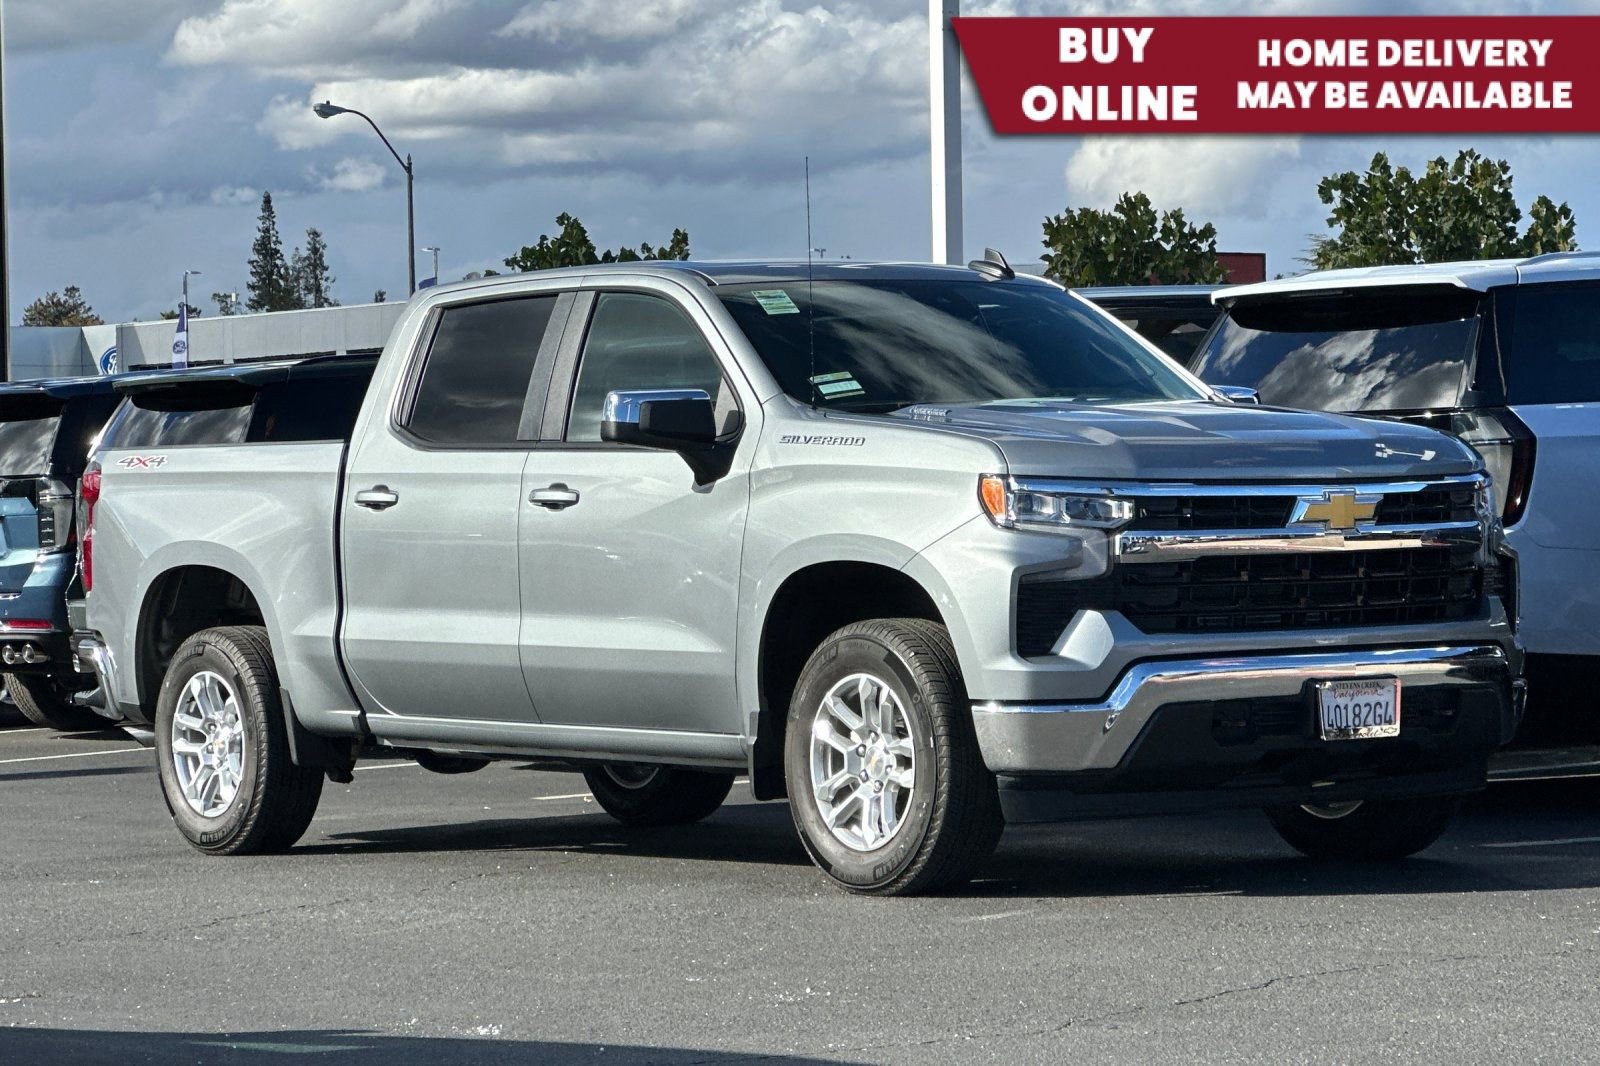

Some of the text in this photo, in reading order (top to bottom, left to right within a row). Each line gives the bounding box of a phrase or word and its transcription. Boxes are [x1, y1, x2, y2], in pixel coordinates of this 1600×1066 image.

[779, 435, 866, 447] SILVERADO
[1333, 688, 1384, 701] California
[1327, 701, 1393, 729] 40182G4
